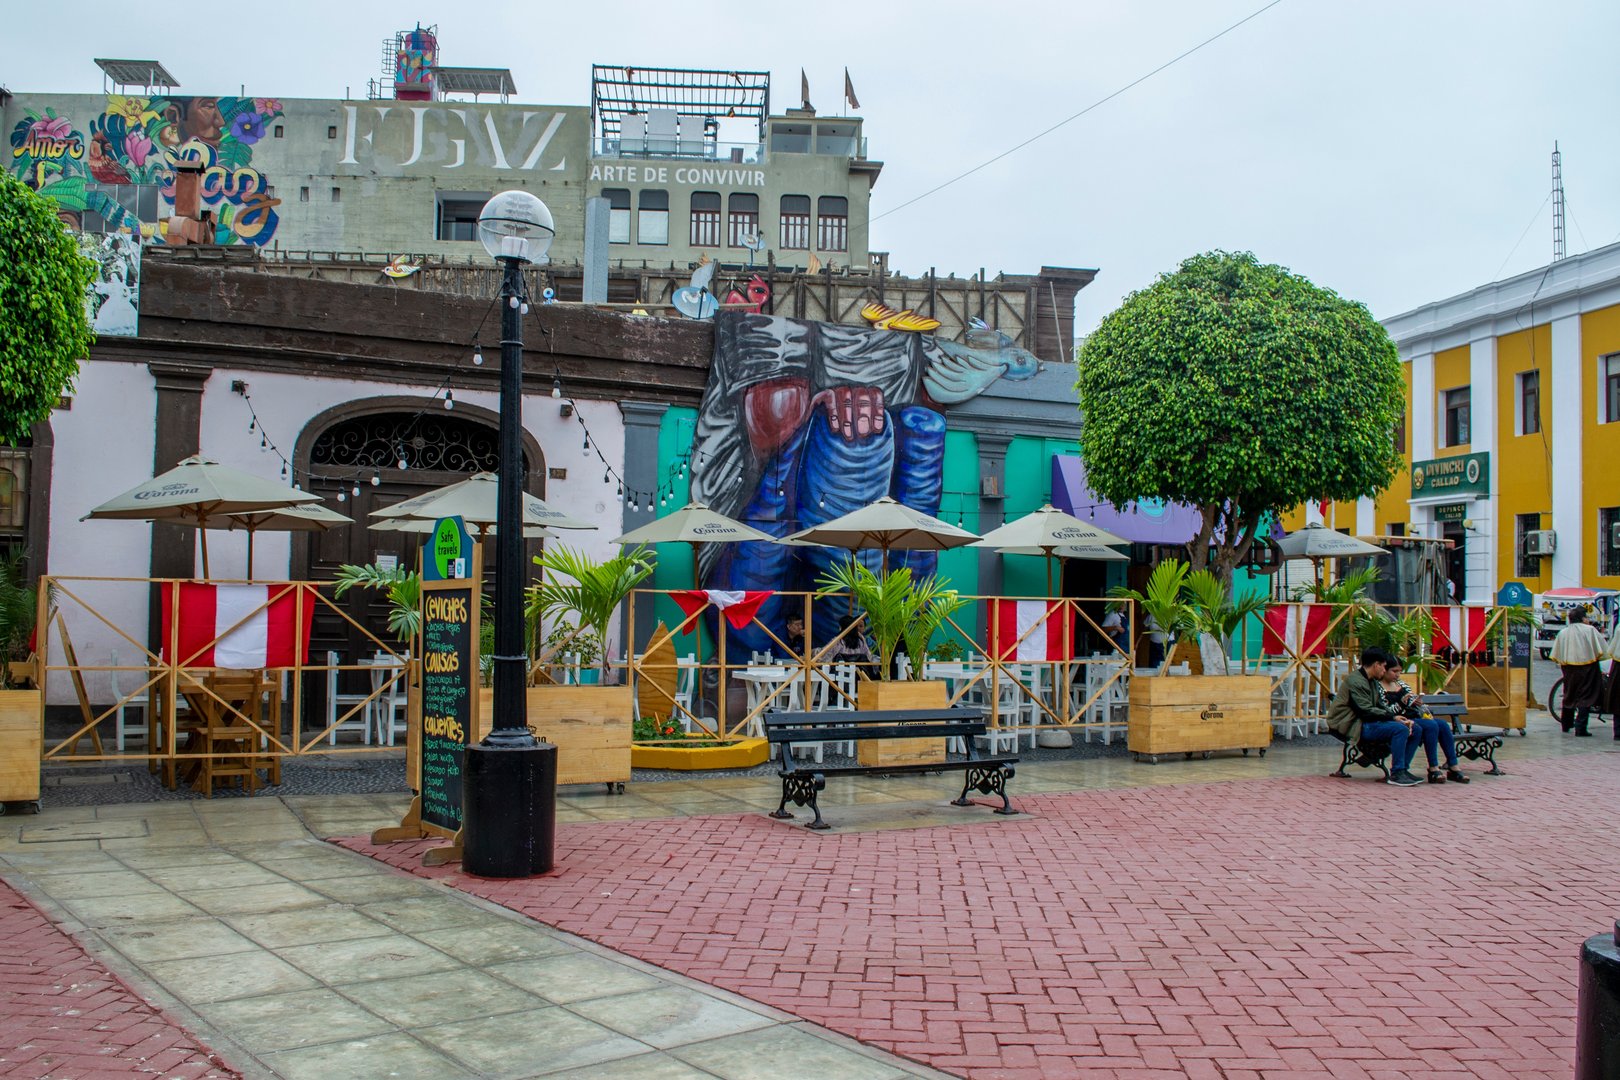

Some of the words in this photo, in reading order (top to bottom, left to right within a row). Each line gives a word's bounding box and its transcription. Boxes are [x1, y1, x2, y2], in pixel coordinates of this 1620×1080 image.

[13, 128, 84, 160] Amor
[590, 165, 637, 182] ARTE
[644, 167, 668, 183] DE
[675, 168, 766, 186] CONVIVIR
[1431, 476, 1459, 487] CALLAO
[134, 487, 199, 499] Corona
[441, 530, 454, 542] Safe
[693, 527, 737, 535] Corona
[1052, 531, 1097, 539] Corona
[438, 542, 458, 555] travels
[1200, 710, 1224, 721] Corona
